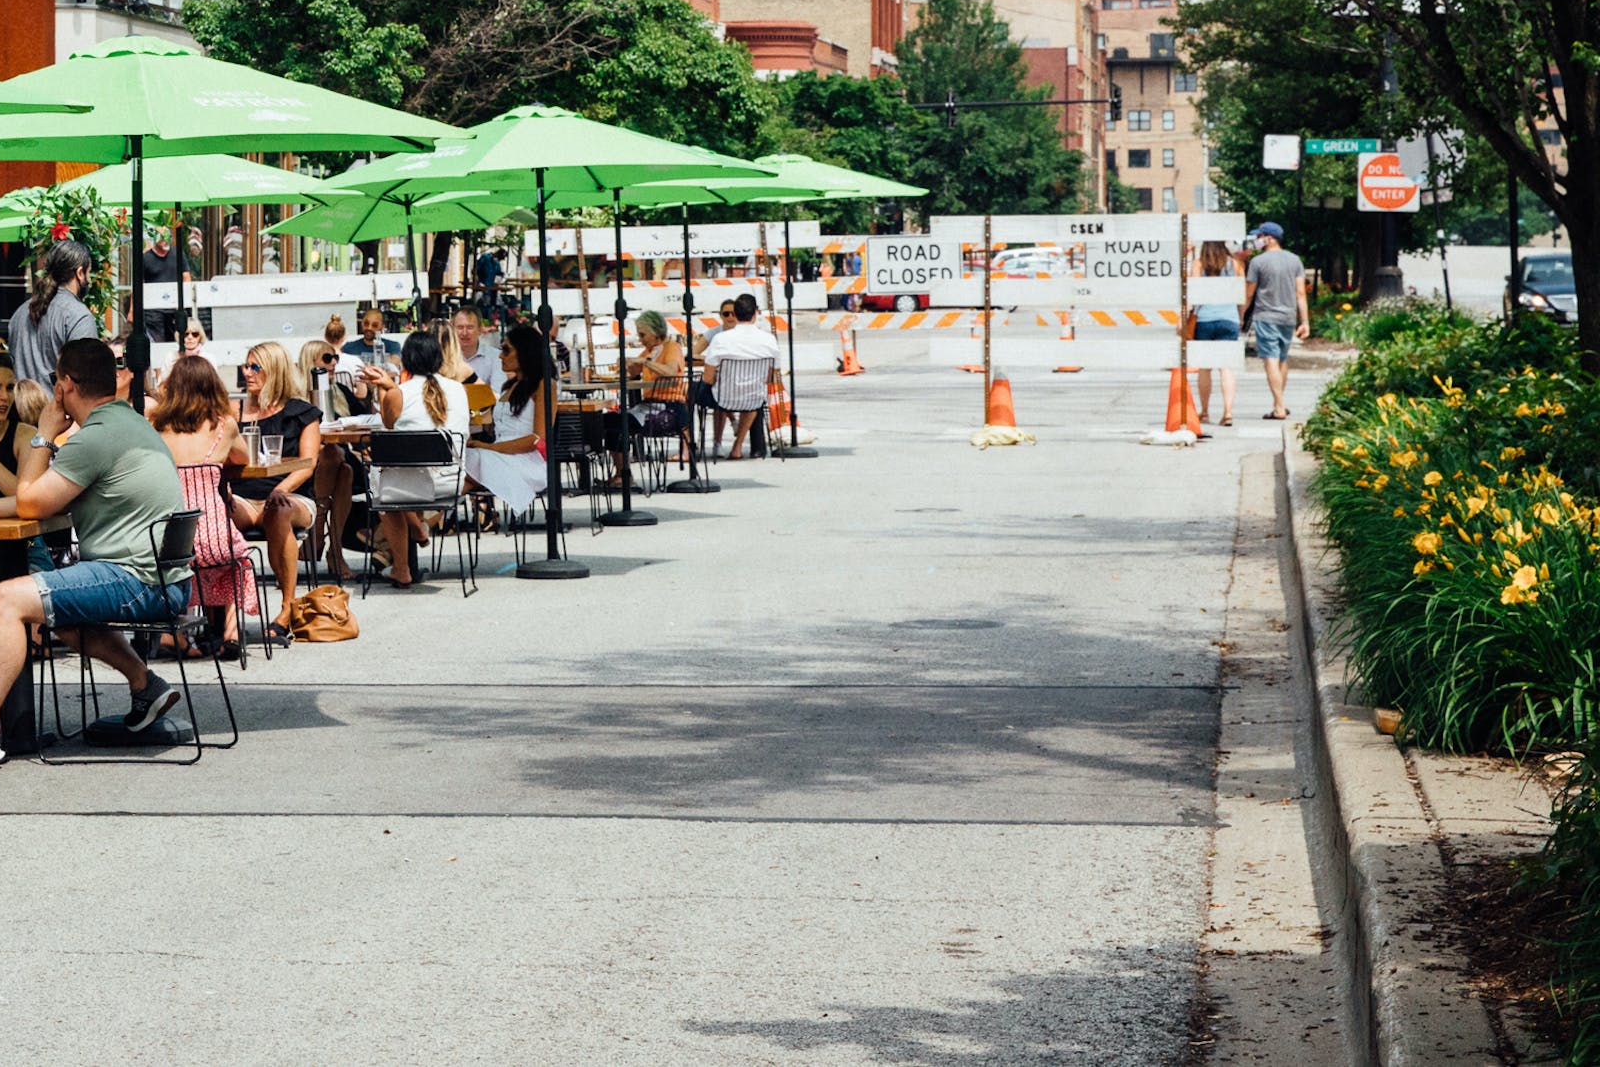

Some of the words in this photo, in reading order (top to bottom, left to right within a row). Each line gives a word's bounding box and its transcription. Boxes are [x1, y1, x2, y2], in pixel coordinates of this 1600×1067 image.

[1323, 140, 1359, 153] GREEN
[1367, 164, 1383, 175] DO
[1372, 189, 1406, 200] ENTER
[887, 244, 942, 262] ROAD
[1104, 241, 1160, 254] ROAD
[1094, 260, 1173, 278] CLOSED
[877, 267, 953, 285] CLOSED
